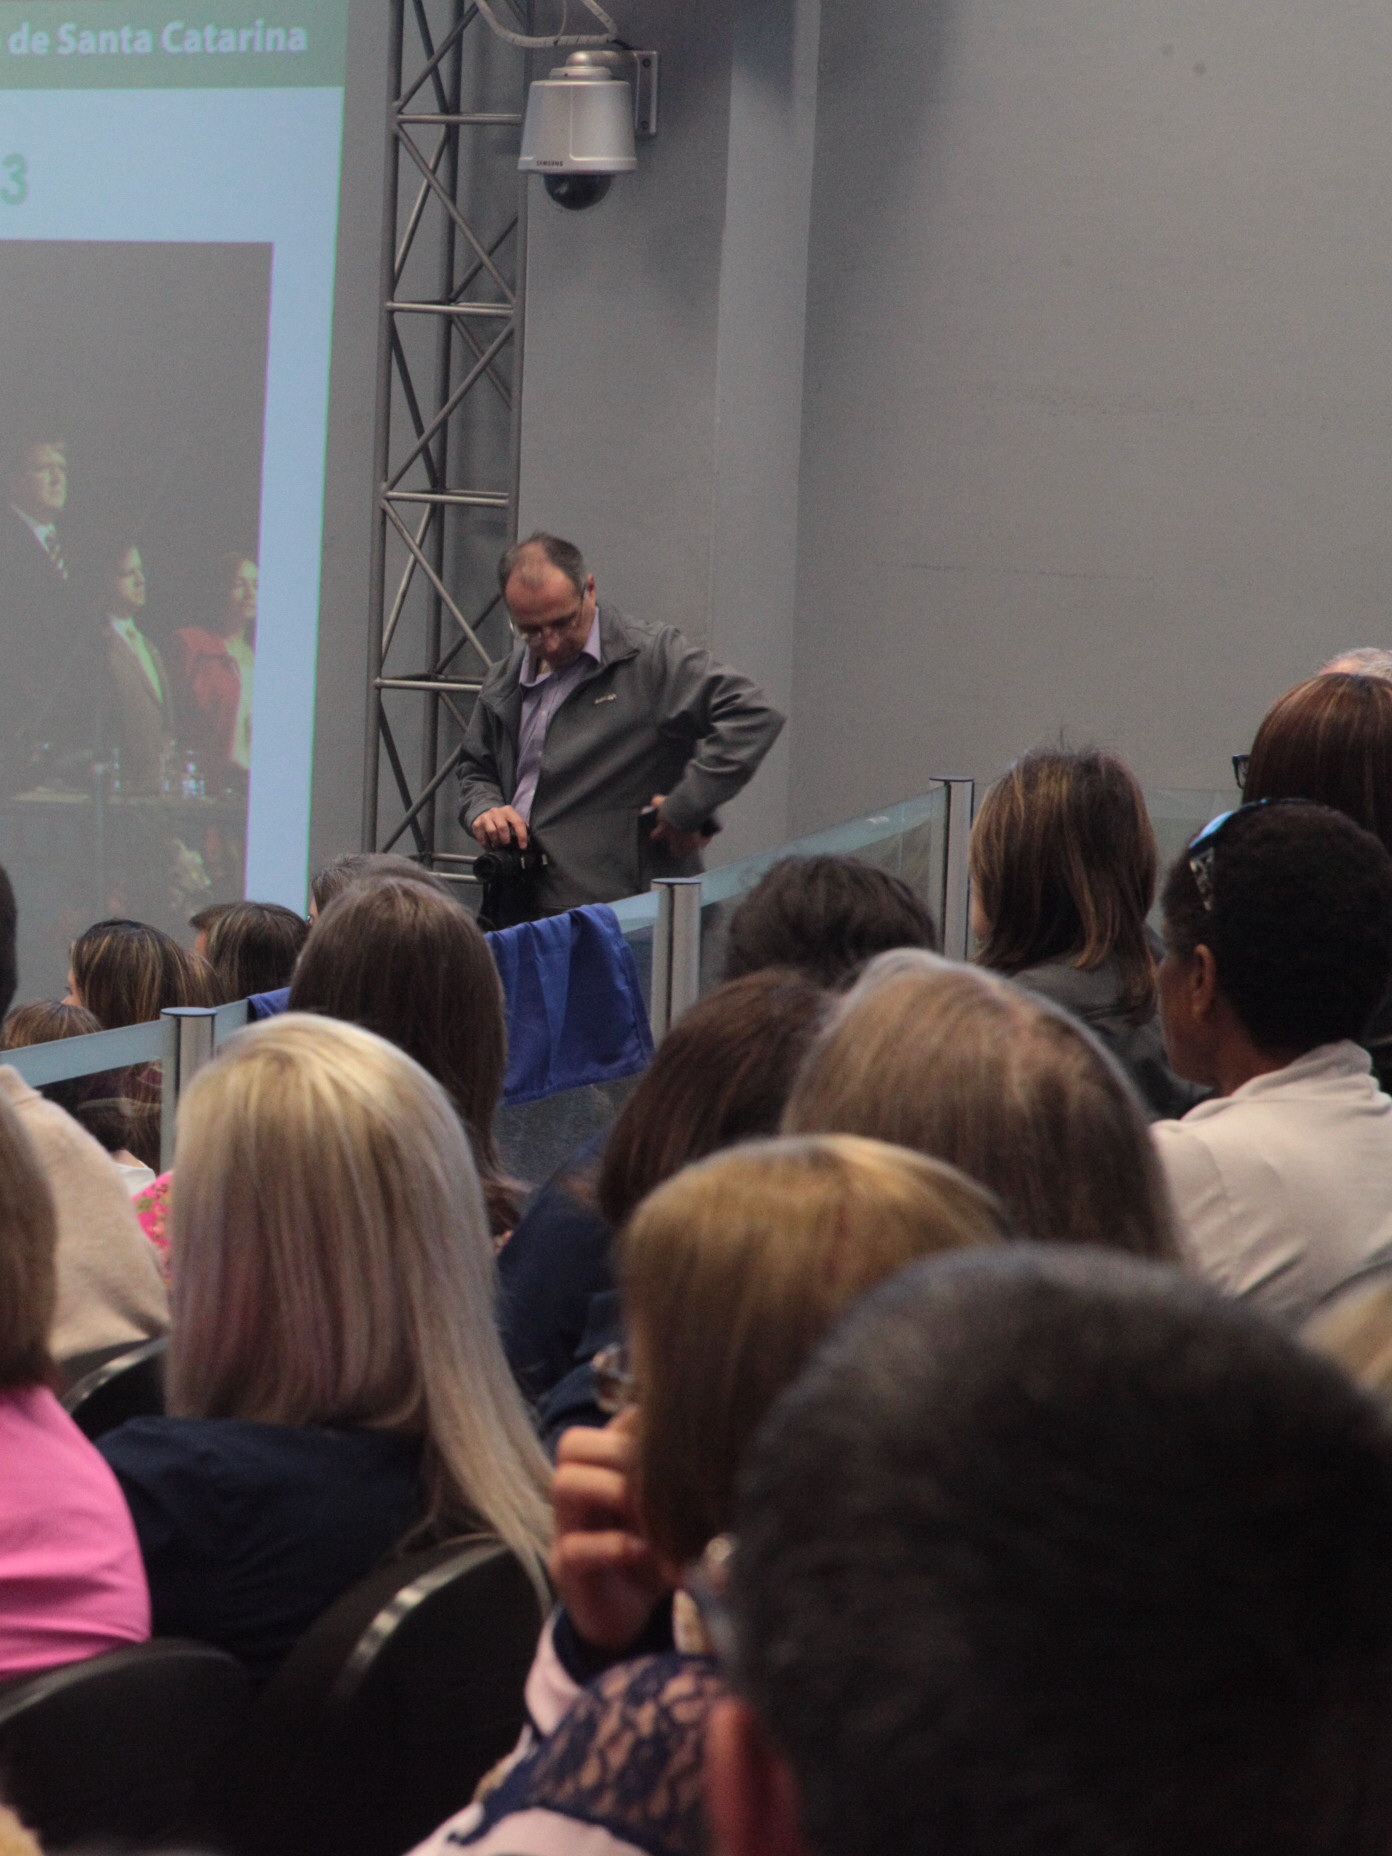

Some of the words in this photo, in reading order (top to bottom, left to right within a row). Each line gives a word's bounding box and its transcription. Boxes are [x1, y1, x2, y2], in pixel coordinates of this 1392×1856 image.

[7, 23, 51, 55] de
[57, 22, 154, 55] Santa
[160, 19, 307, 53] Catarina
